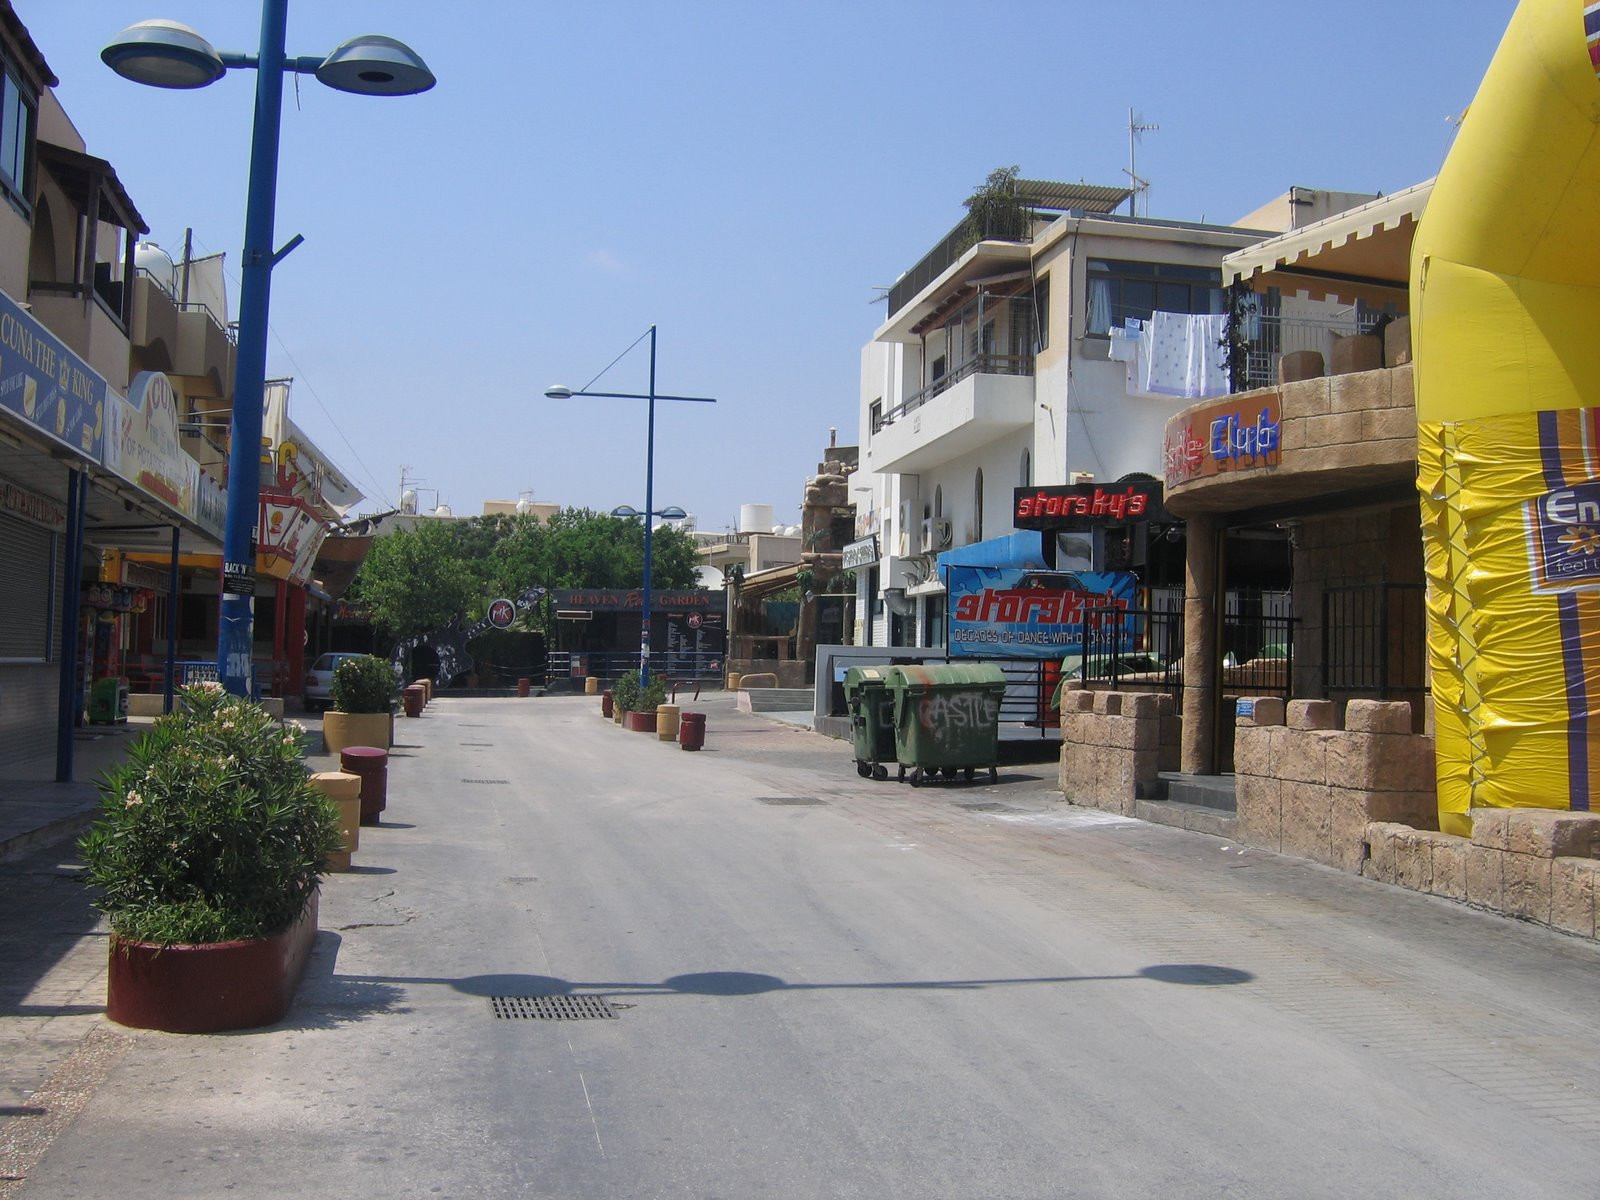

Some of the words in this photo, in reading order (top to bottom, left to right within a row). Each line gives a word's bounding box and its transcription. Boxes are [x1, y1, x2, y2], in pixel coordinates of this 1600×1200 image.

[0, 312, 34, 363] CUNA
[35, 338, 56, 379] THE
[71, 366, 94, 406] KING
[1209, 405, 1279, 463] Club
[224, 562, 240, 574] BLACK
[1556, 559, 1588, 572] feel
[568, 595, 618, 606] HEAVEN
[659, 595, 710, 606] GARDEN
[954, 628, 999, 643] DECADES
[1001, 631, 1015, 643] OF
[1017, 631, 1050, 644] DANCE
[1051, 631, 1073, 644] WITH
